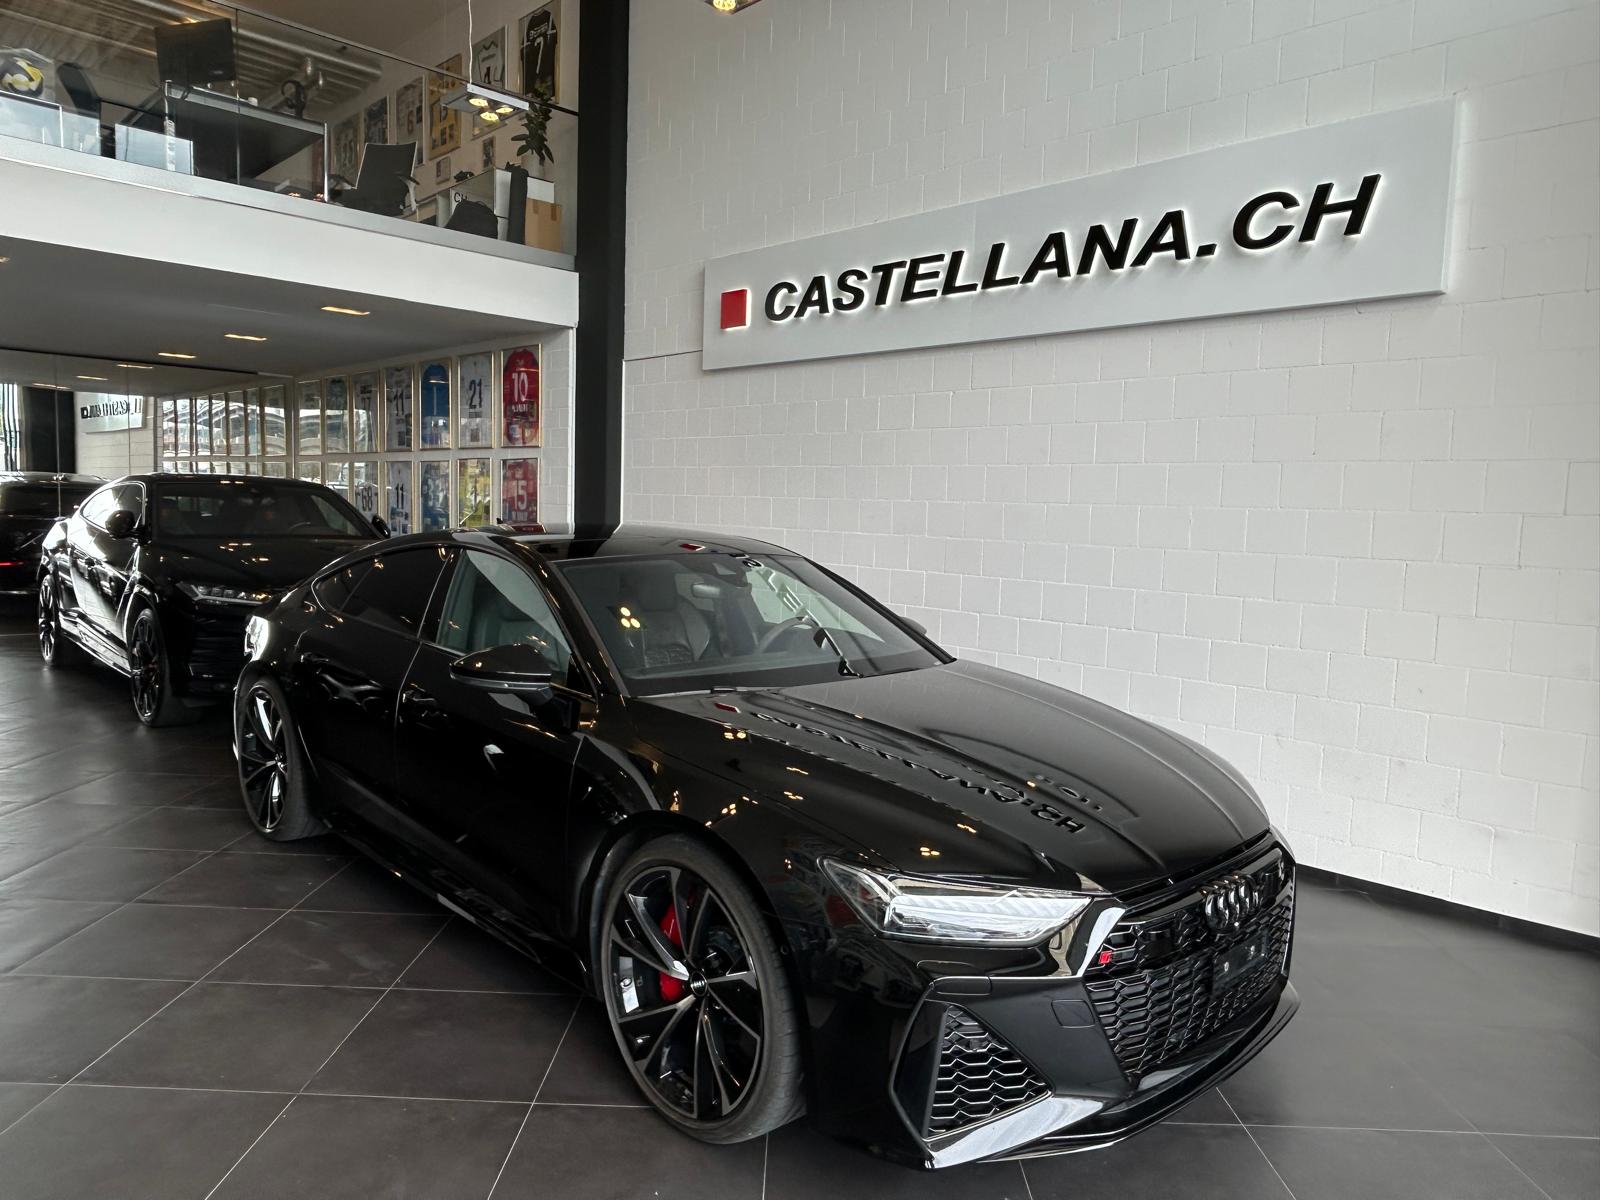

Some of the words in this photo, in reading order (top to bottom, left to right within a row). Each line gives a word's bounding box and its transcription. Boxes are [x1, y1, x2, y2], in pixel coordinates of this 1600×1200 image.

[764, 173, 1382, 322] CASTELLANA.CH
[469, 378, 483, 410] 21
[512, 371, 529, 402] 10
[511, 479, 528, 511] 15
